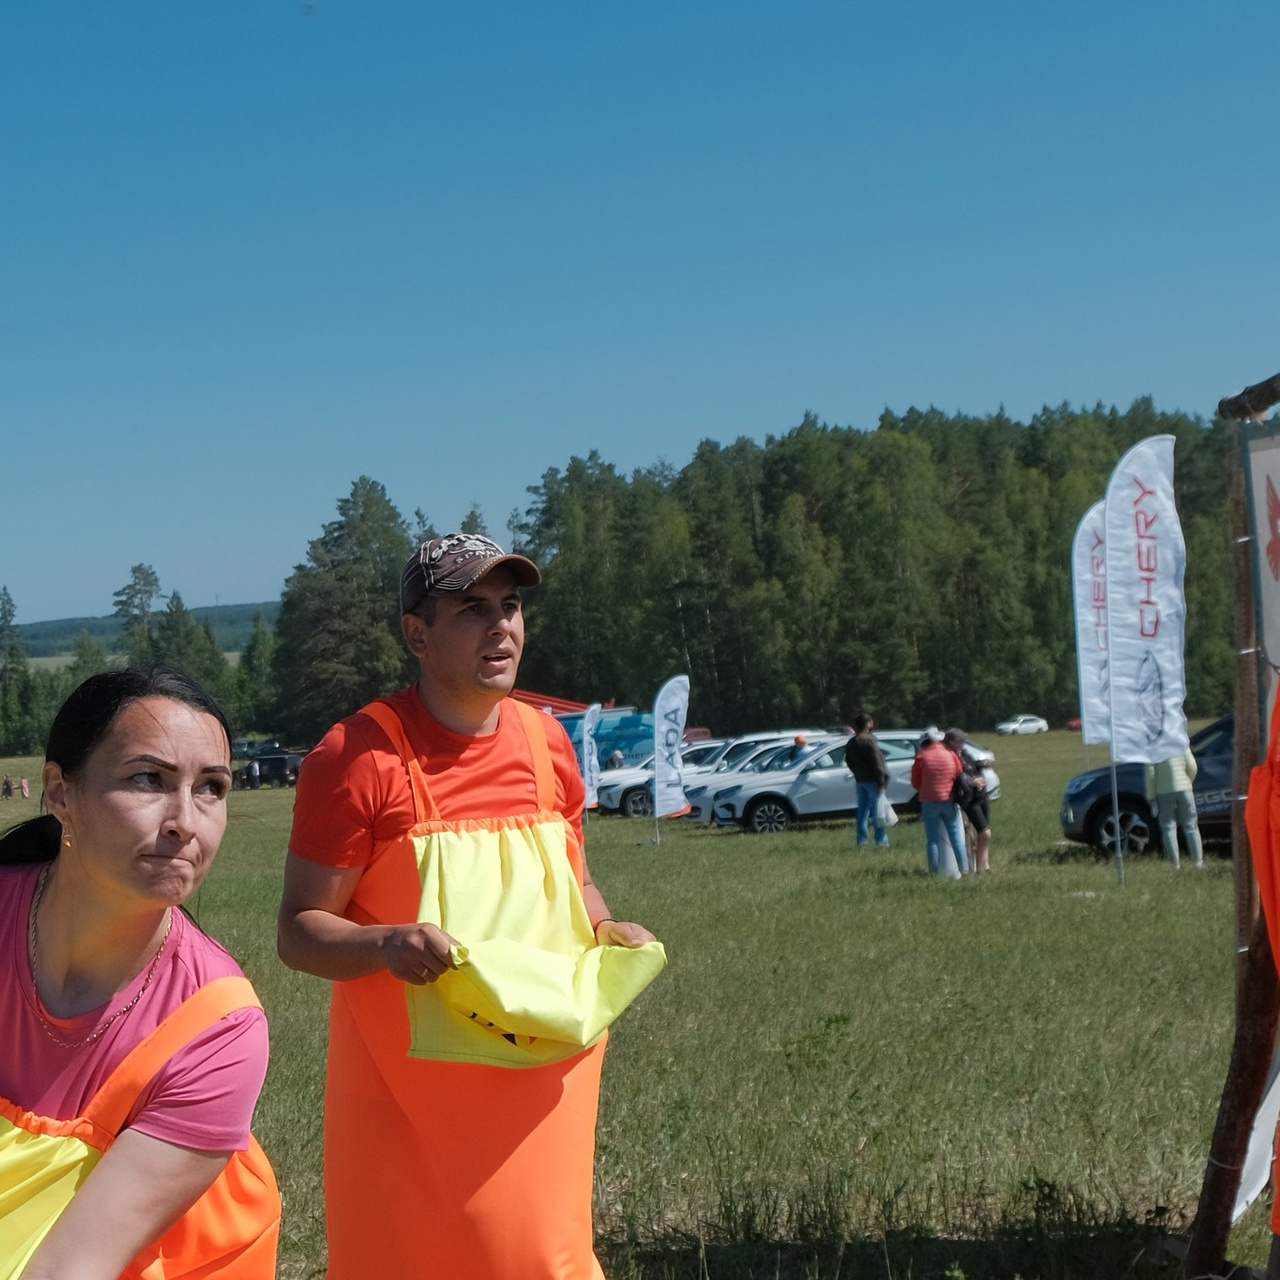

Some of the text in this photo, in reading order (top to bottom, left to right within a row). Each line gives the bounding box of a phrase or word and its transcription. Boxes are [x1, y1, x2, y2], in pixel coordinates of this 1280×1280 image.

[1091, 528, 1108, 651] CHERY
[1132, 475, 1160, 638] CHERY
[664, 707, 682, 788] LADA
